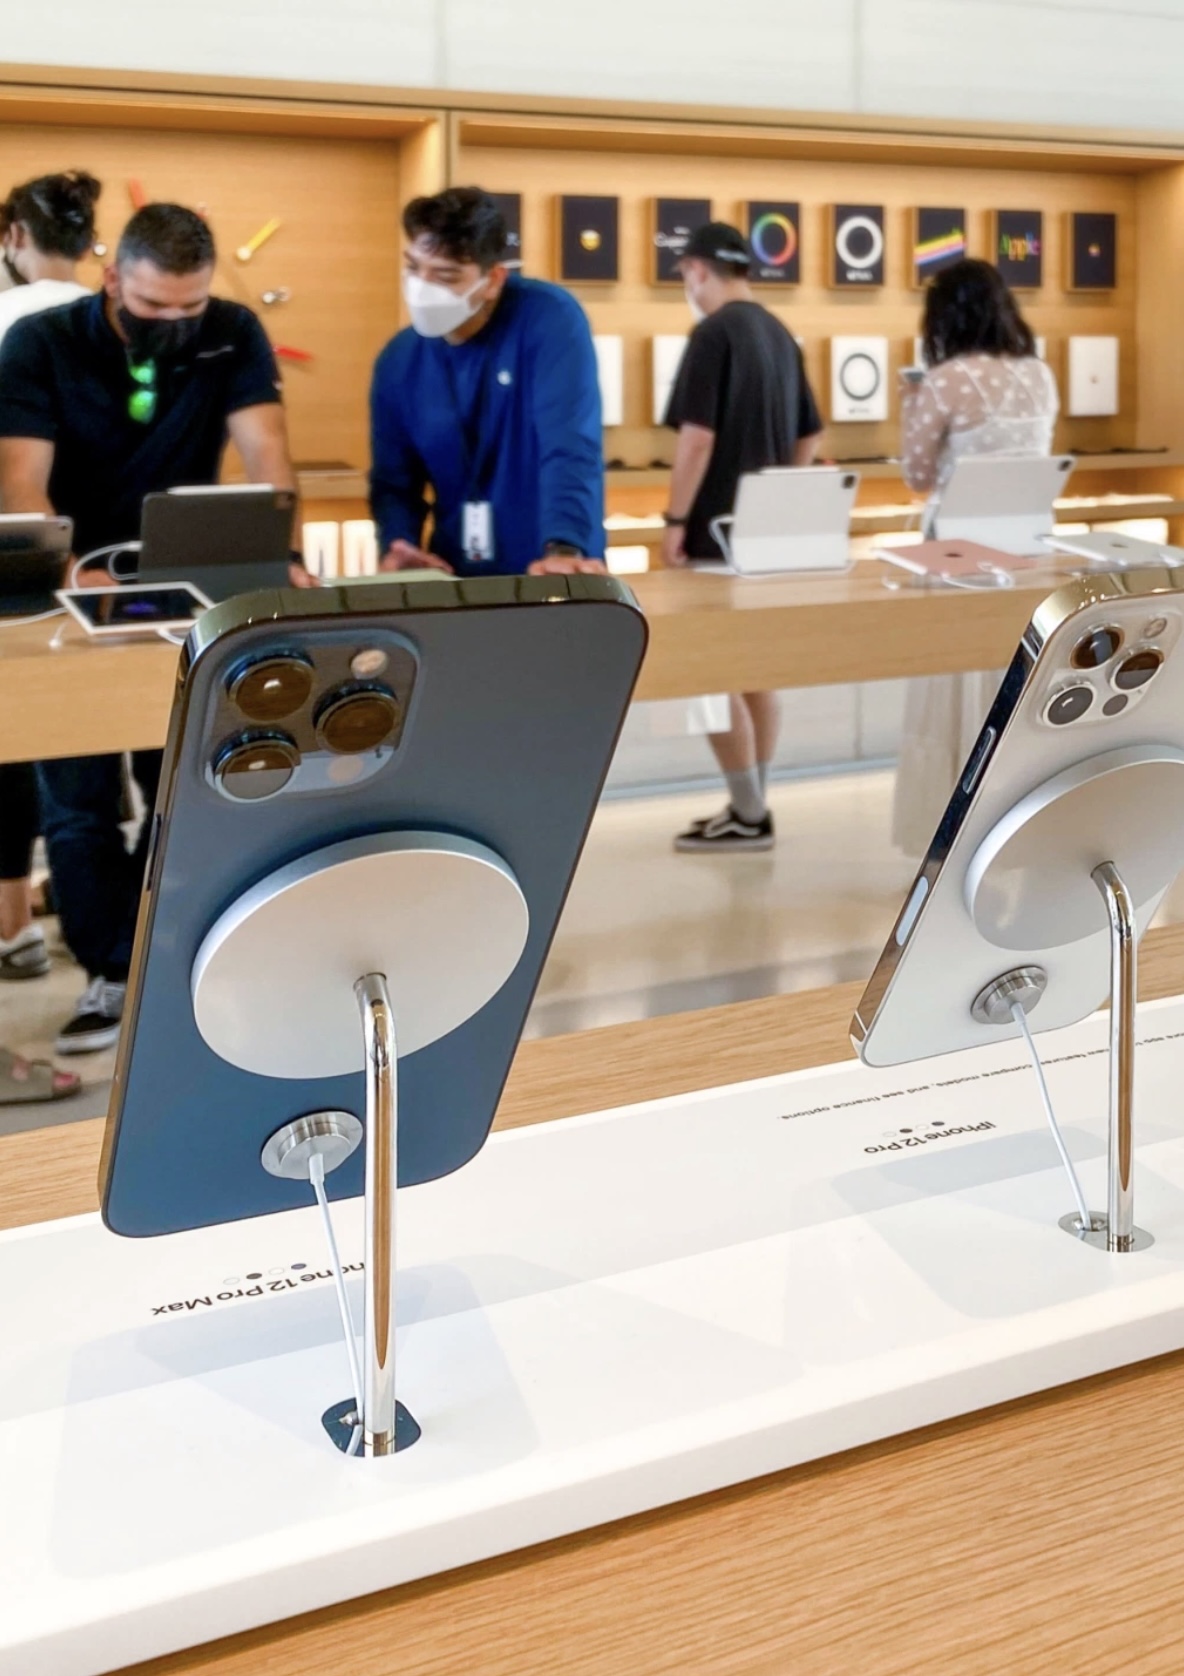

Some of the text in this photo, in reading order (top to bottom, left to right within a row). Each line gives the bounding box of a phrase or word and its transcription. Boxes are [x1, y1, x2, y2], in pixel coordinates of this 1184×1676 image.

[881, 1090, 905, 1099] see
[906, 1085, 930, 1095] and
[832, 1096, 881, 1109] finance
[864, 1121, 996, 1153] iPhone 12 Pro
[266, 1278, 297, 1291] 12
[217, 1285, 264, 1300] Pro
[151, 1296, 213, 1315] Max
